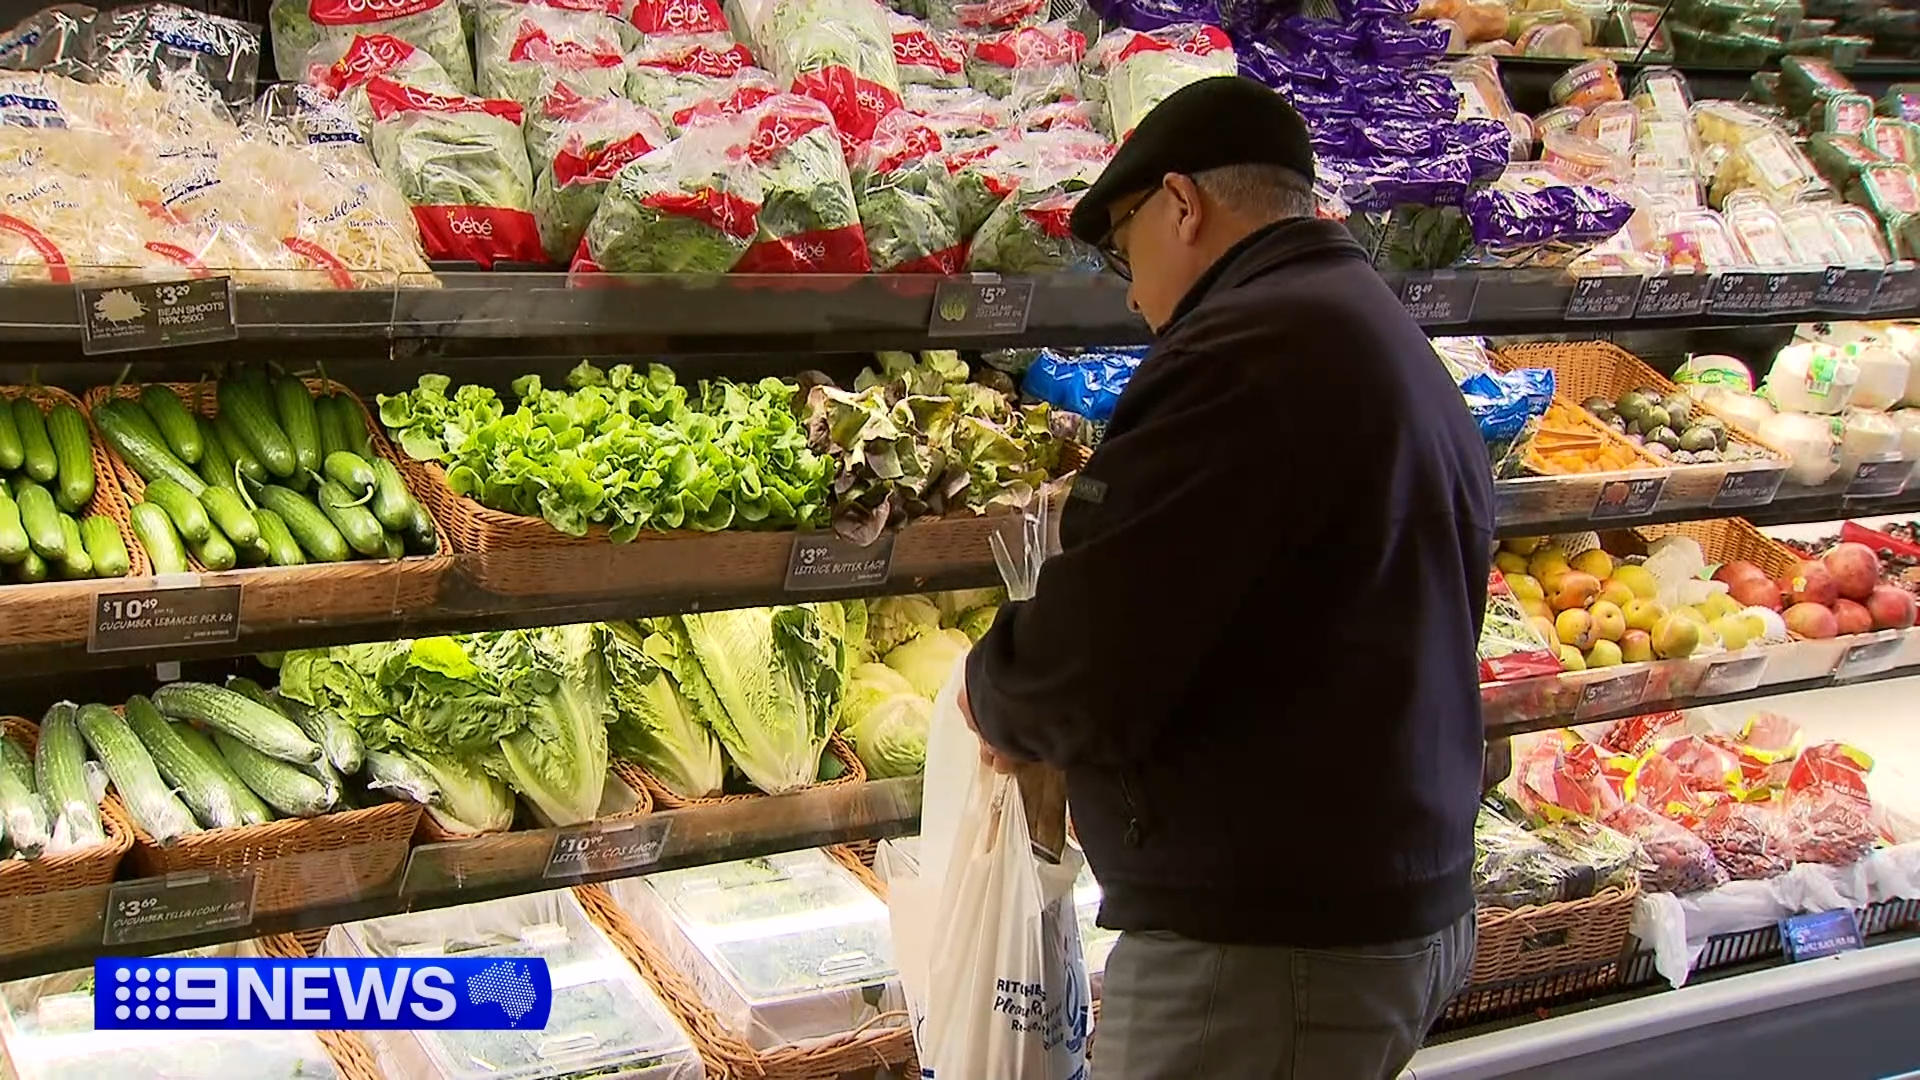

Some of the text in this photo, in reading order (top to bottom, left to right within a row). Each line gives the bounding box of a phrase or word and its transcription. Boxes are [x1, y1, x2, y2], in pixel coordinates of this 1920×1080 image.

[450, 215, 493, 235] bébé
[157, 301, 225, 317] BEAN SHOOTS
[800, 547, 828, 564] $399
[794, 559, 885, 575] LETTUCE BUTTER EACH
[103, 598, 158, 620] $1049
[99, 613, 233, 632] CUCUMBER LEBANESE PER KG
[552, 849, 600, 864] LETTUCE
[602, 846, 626, 858] COS
[628, 841, 659, 854] EACH
[113, 912, 167, 927] CUCUMBER
[223, 901, 246, 911] EACH
[118, 897, 158, 917] $369
